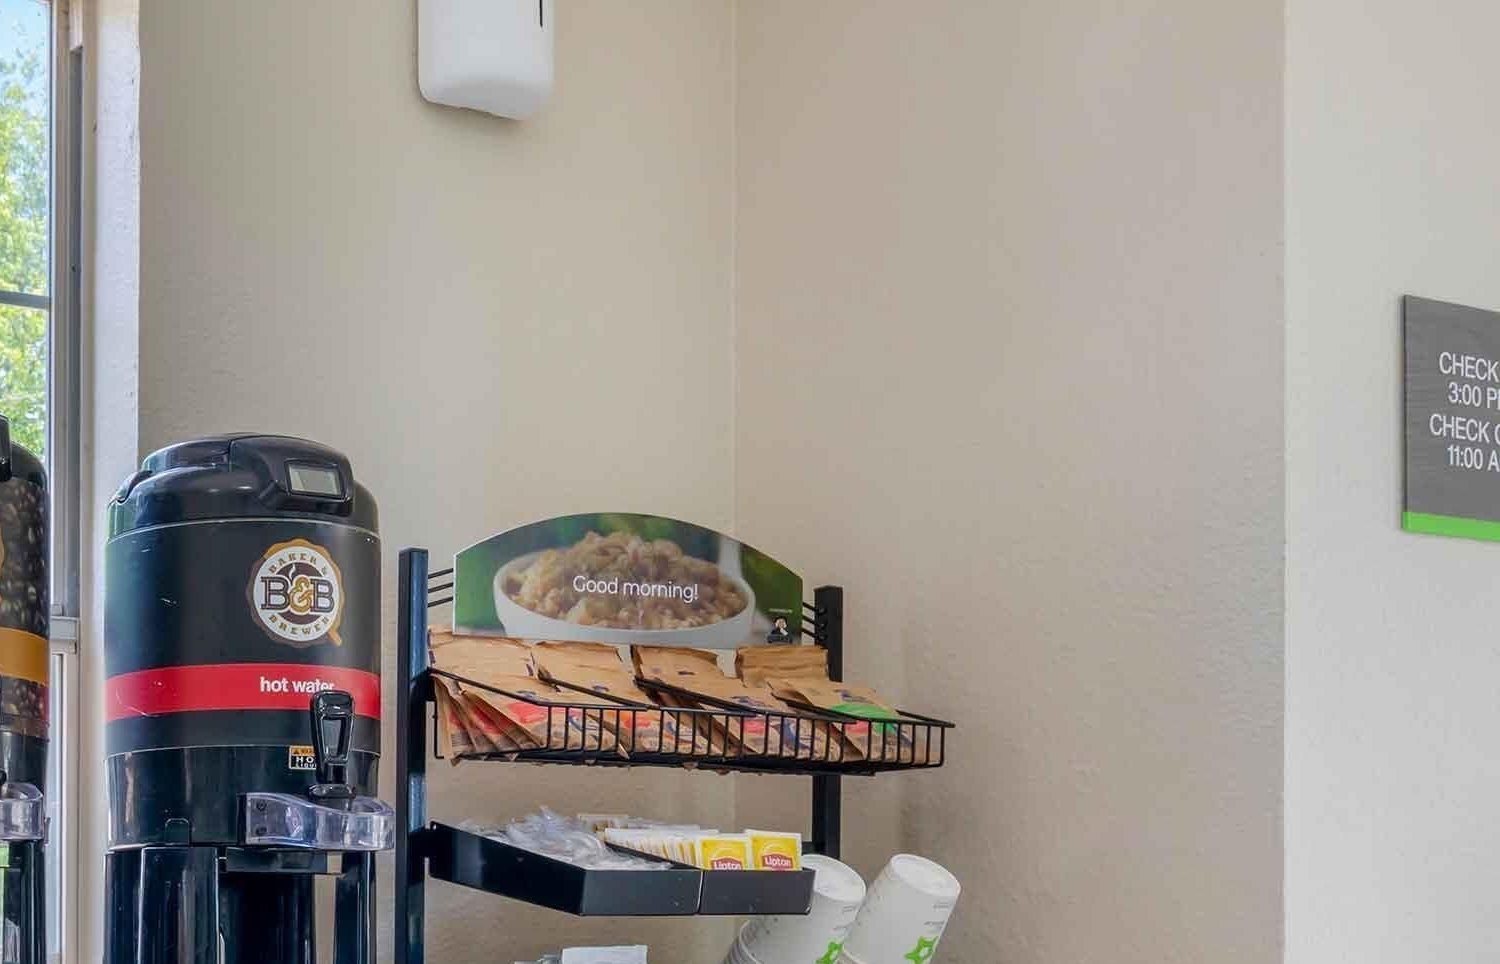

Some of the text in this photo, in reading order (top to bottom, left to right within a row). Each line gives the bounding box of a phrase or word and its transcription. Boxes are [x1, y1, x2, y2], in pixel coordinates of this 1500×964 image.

[1439, 352, 1499, 383] CHECK
[1448, 382, 1500, 410] 3:00 P
[1429, 413, 1490, 444] CHECK
[1447, 445, 1484, 470] 11:00
[268, 553, 317, 573] BAKER
[261, 576, 335, 613] B&B
[573, 575, 699, 604] Good morning!
[268, 614, 329, 635] BREWER
[260, 676, 335, 694] hot water
[713, 861, 742, 870] Lipton
[764, 856, 792, 867] Lipton
